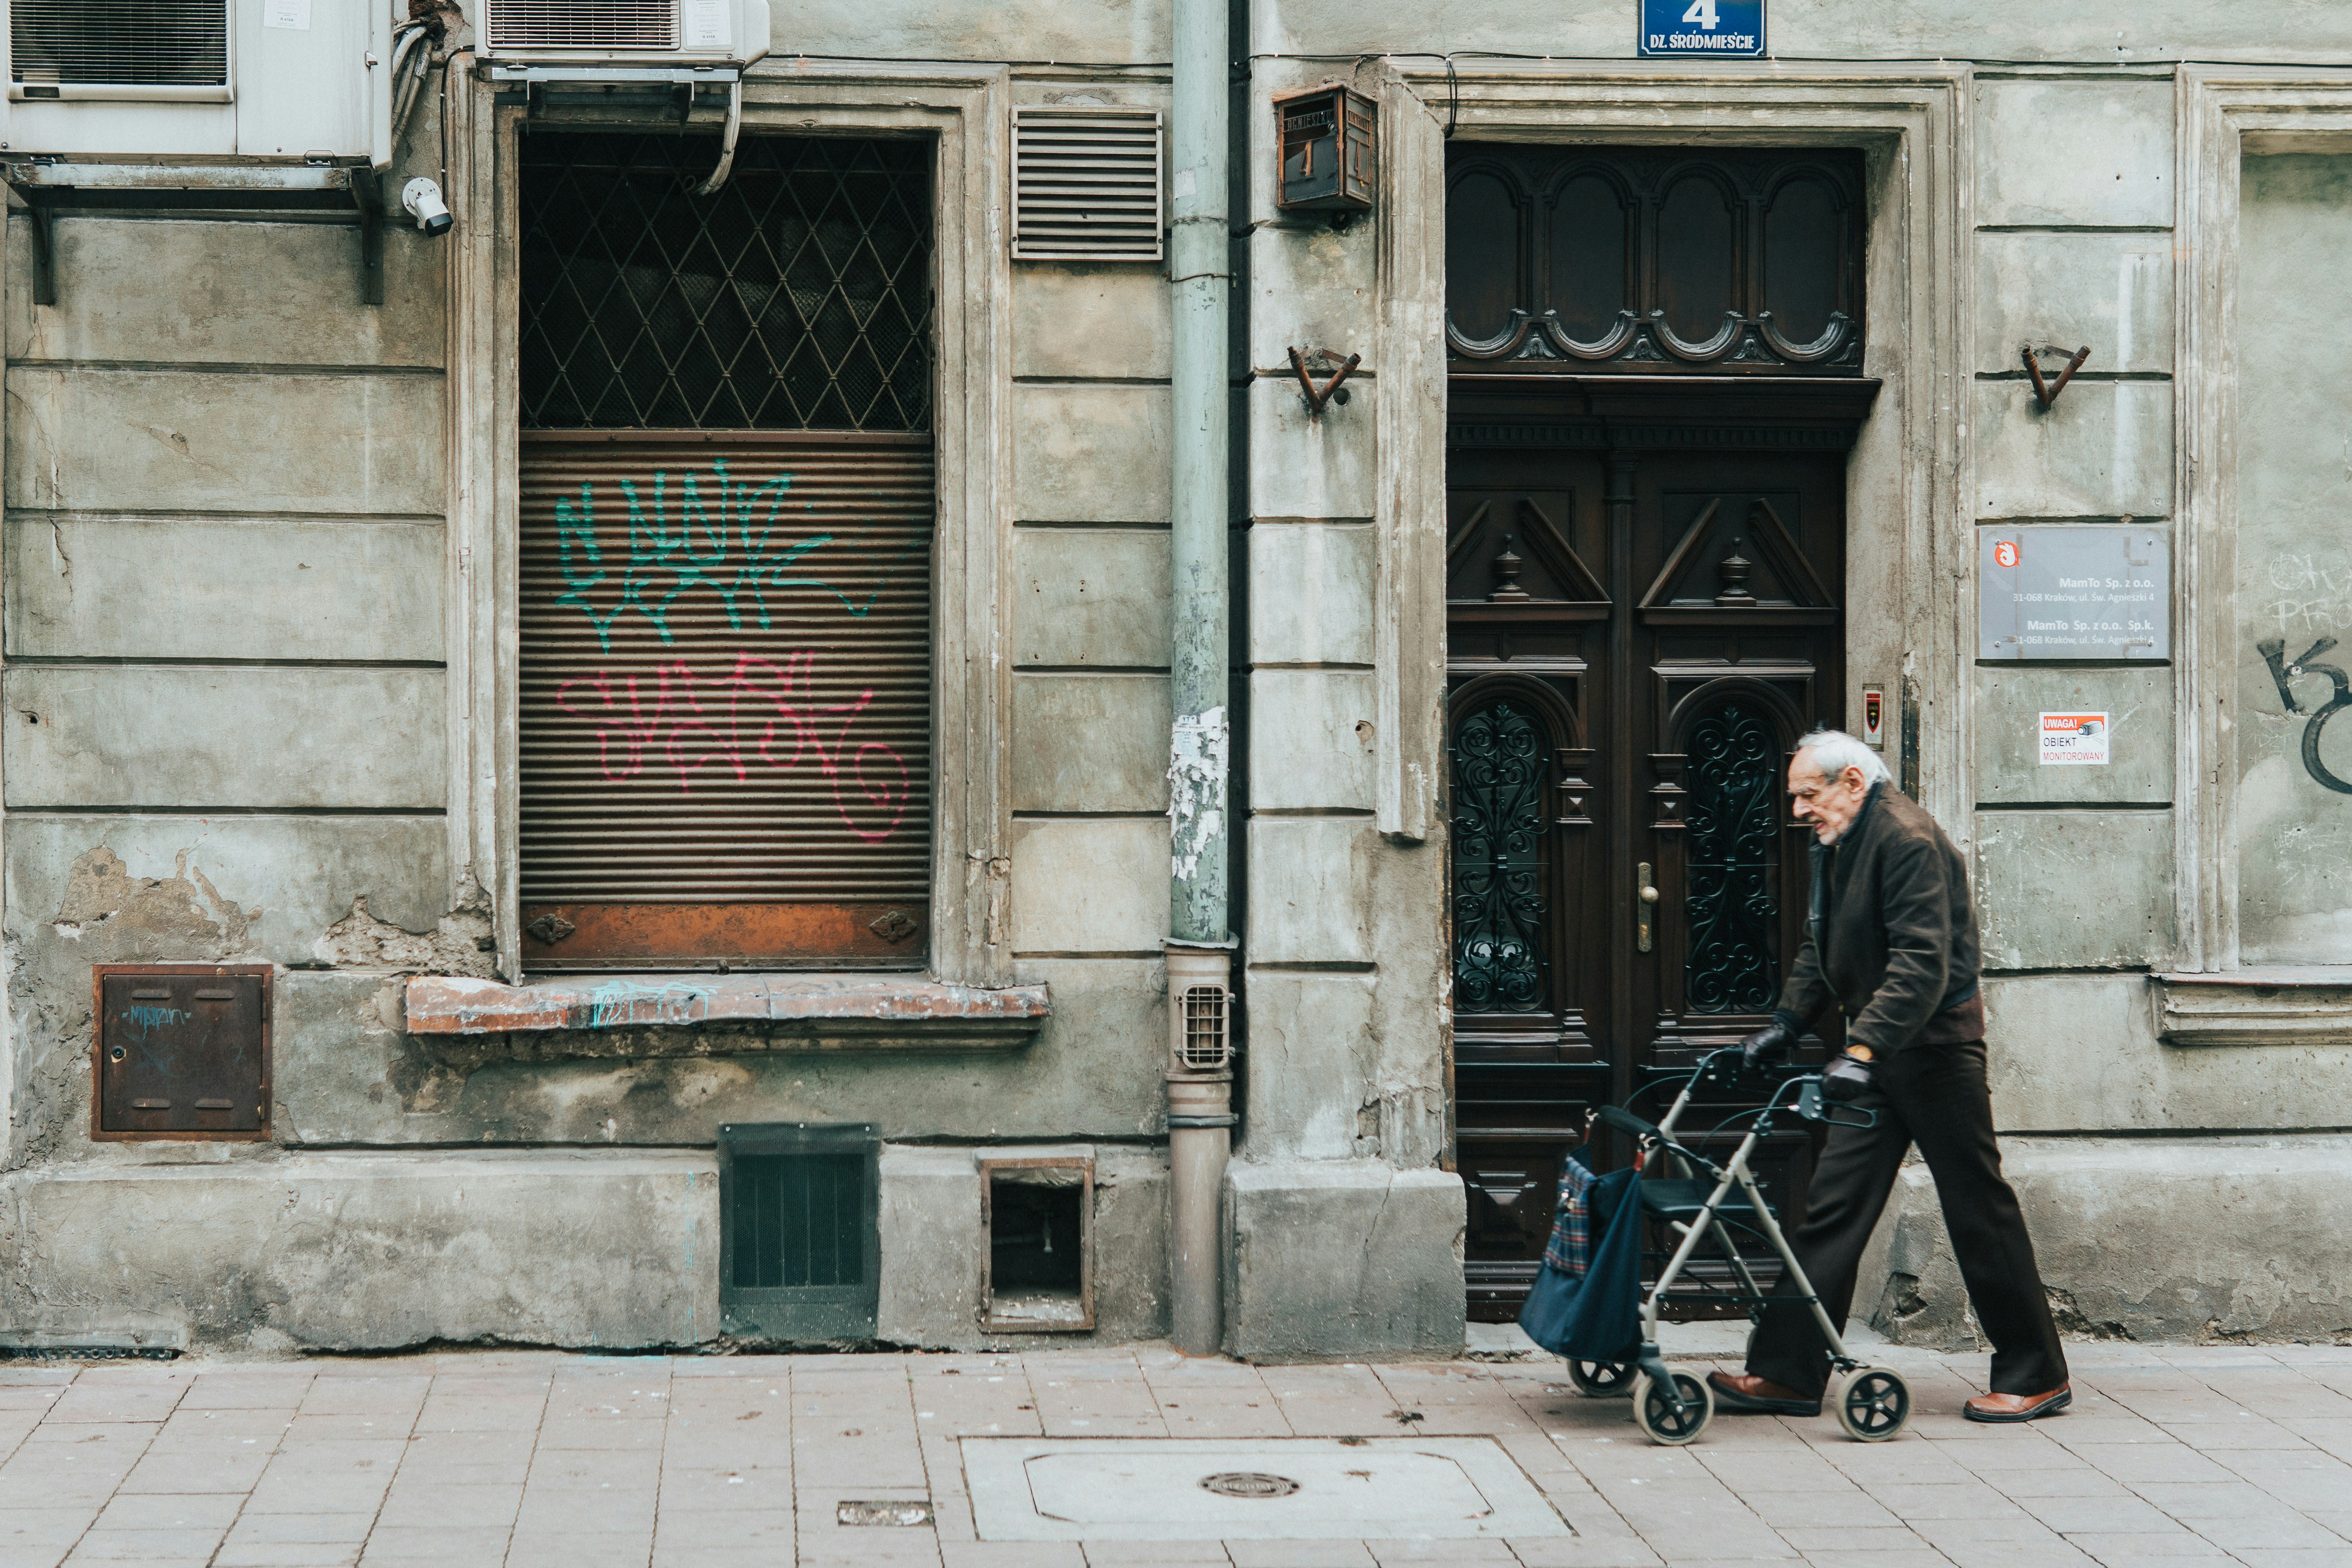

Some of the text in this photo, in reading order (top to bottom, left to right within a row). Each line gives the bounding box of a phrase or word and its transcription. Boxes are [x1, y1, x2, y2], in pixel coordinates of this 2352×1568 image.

[1682, 0, 1720, 29] 4
[1650, 30, 1755, 49] DZ. ŚRÓDMIEŚCIE
[2060, 578, 2100, 587] MamTo
[2106, 578, 2122, 589] Sp.
[2045, 593, 2076, 603] Kraków,
[2080, 593, 2089, 601] ul.
[2091, 592, 2105, 601] Św.
[2108, 593, 2146, 603] Agnieszki
[2028, 621, 2068, 630] MamTo
[2074, 621, 2090, 632] Sp.
[2128, 620, 2154, 632] Sp.k.
[2013, 636, 2042, 644] 31-068
[2045, 635, 2076, 645] Kraków,
[2080, 635, 2089, 644] ul.
[2091, 634, 2105, 644] Św.
[2108, 636, 2146, 646] Agnieszki
[2045, 719, 2077, 728] UWAGA!
[2044, 737, 2076, 746] OBIEKT
